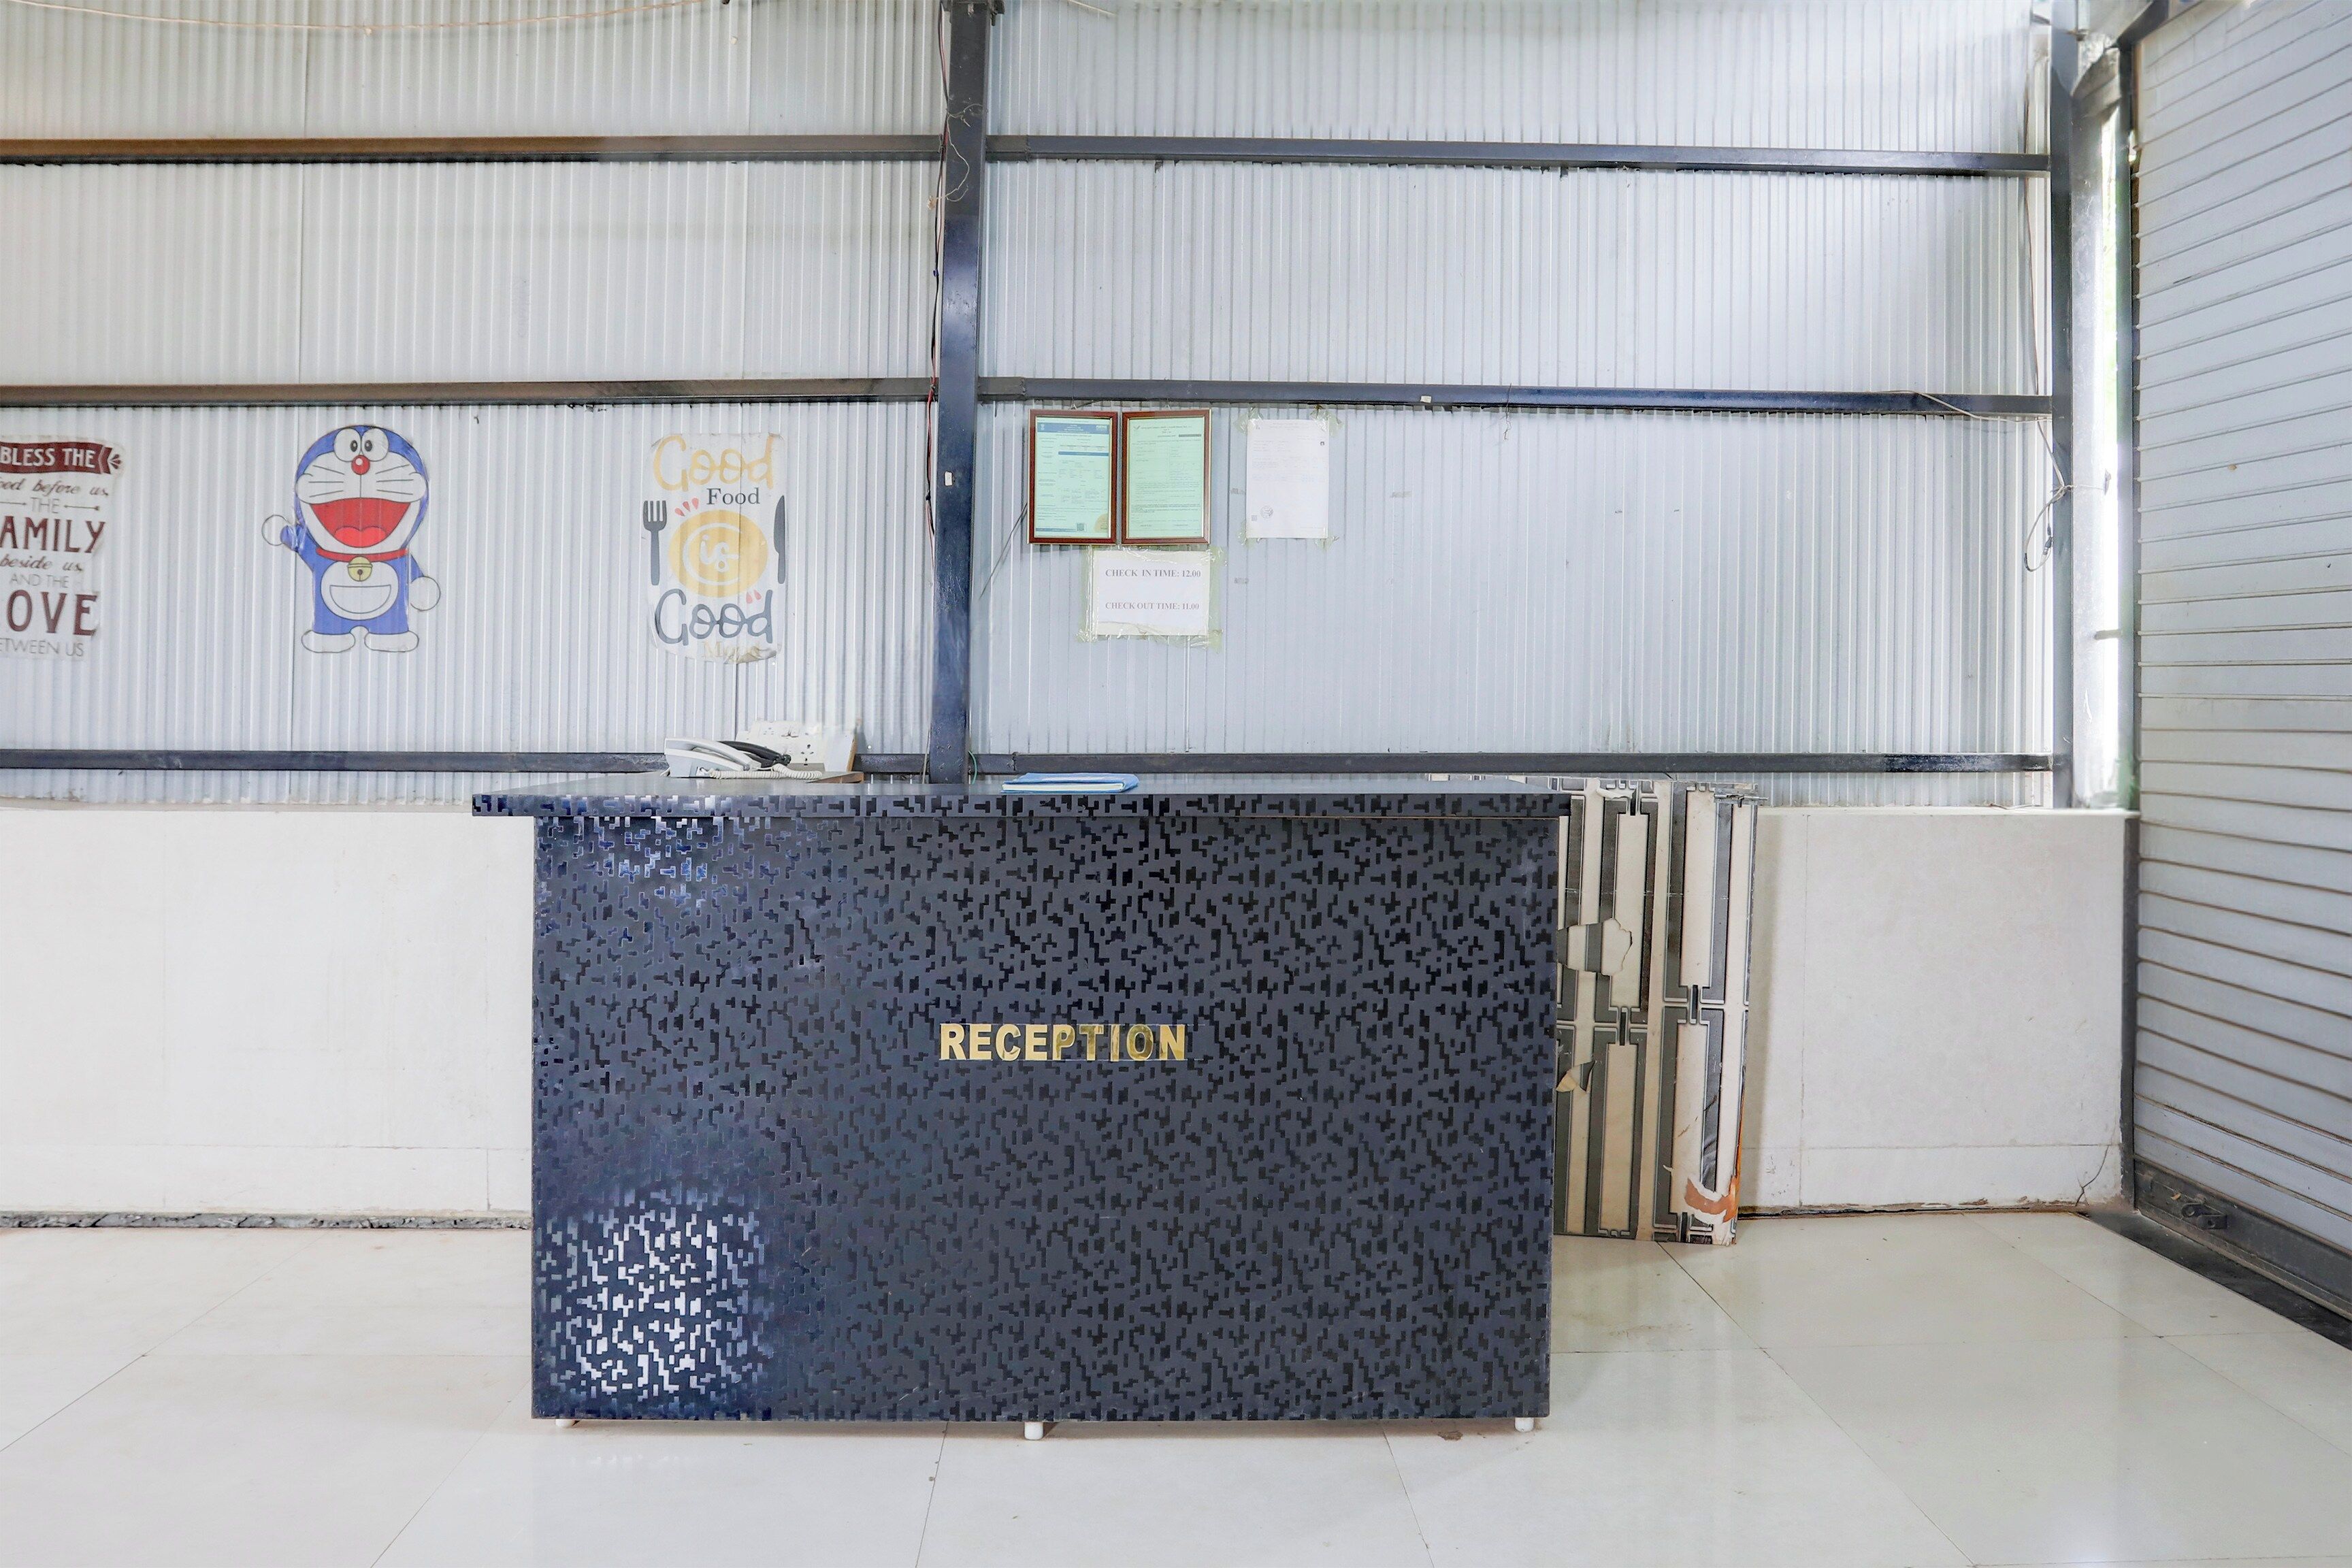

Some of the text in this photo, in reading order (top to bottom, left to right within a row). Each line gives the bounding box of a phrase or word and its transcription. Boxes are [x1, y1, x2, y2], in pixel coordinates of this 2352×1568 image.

[0, 446, 96, 468] BLESS THE
[33, 479, 81, 497] before
[706, 488, 760, 504] Food
[31, 497, 60, 513] THE
[0, 516, 105, 553] AMILY
[0, 554, 52, 570] beside
[10, 574, 69, 588] AND THE
[1105, 569, 1137, 577] CHECK
[7, 589, 97, 636] OVE
[655, 588, 773, 646] Good
[65, 642, 84, 657] US
[940, 1023, 1186, 1062] RECEPTION
